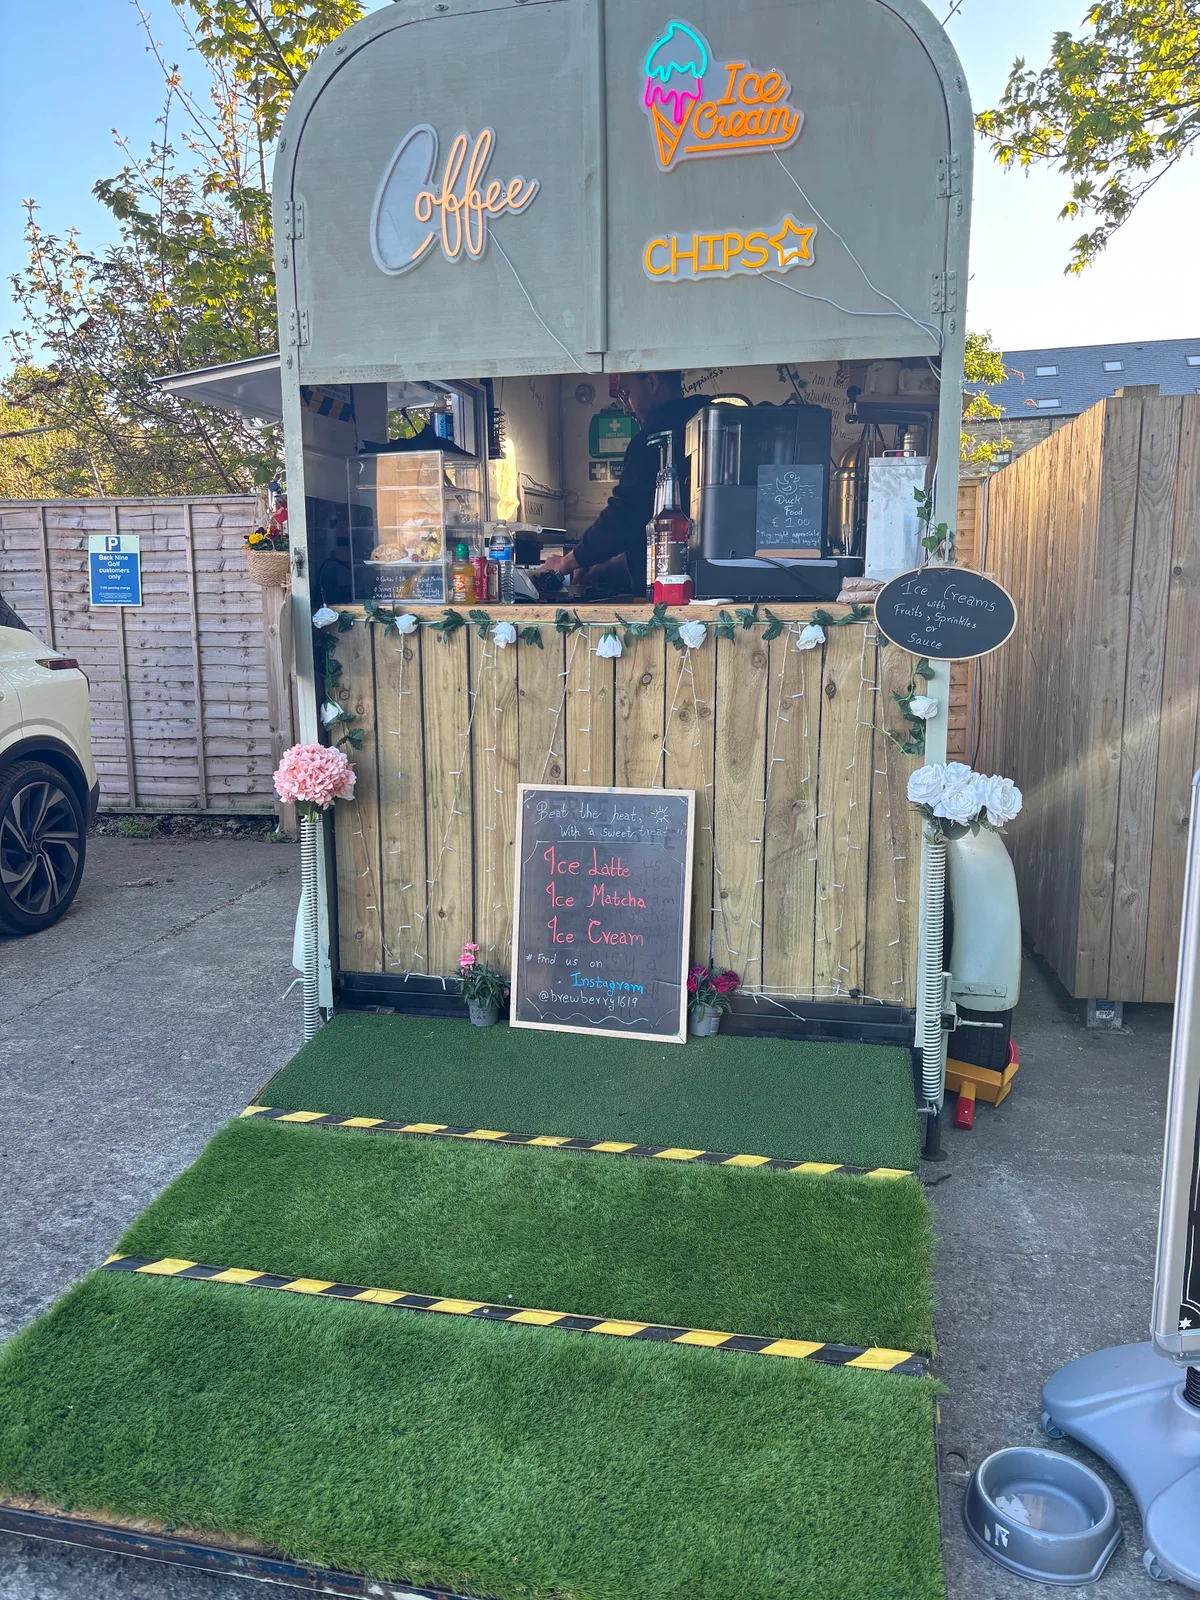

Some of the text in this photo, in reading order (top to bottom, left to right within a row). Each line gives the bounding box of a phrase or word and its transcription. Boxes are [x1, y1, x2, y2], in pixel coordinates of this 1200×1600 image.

[718, 64, 785, 105] Ice
[693, 103, 798, 139] Cream
[377, 128, 536, 269] Coffee
[645, 232, 768, 275] CHIPS
[821, 391, 840, 406] likes
[774, 495, 801, 504] Duck
[784, 505, 803, 516] Food
[108, 537, 119, 551] P
[901, 578, 997, 612] Ice Creams
[927, 600, 946, 610] with
[926, 625, 938, 633] or
[934, 612, 977, 629] Sprinkles
[907, 633, 943, 650] Sauce
[535, 801, 570, 824] Beat
[580, 802, 602, 819] the
[588, 828, 595, 837] a
[639, 825, 669, 837] treat
[543, 846, 581, 875] Ice
[588, 848, 630, 877] Latte
[545, 881, 575, 908] Ice
[586, 883, 647, 908] Matcha
[547, 916, 644, 946] Ice Cream
[537, 953, 557, 965] Find
[565, 958, 578, 966] us
[589, 960, 603, 968] on
[570, 972, 644, 996] Instagram
[538, 989, 639, 1011] @brewberry1619
